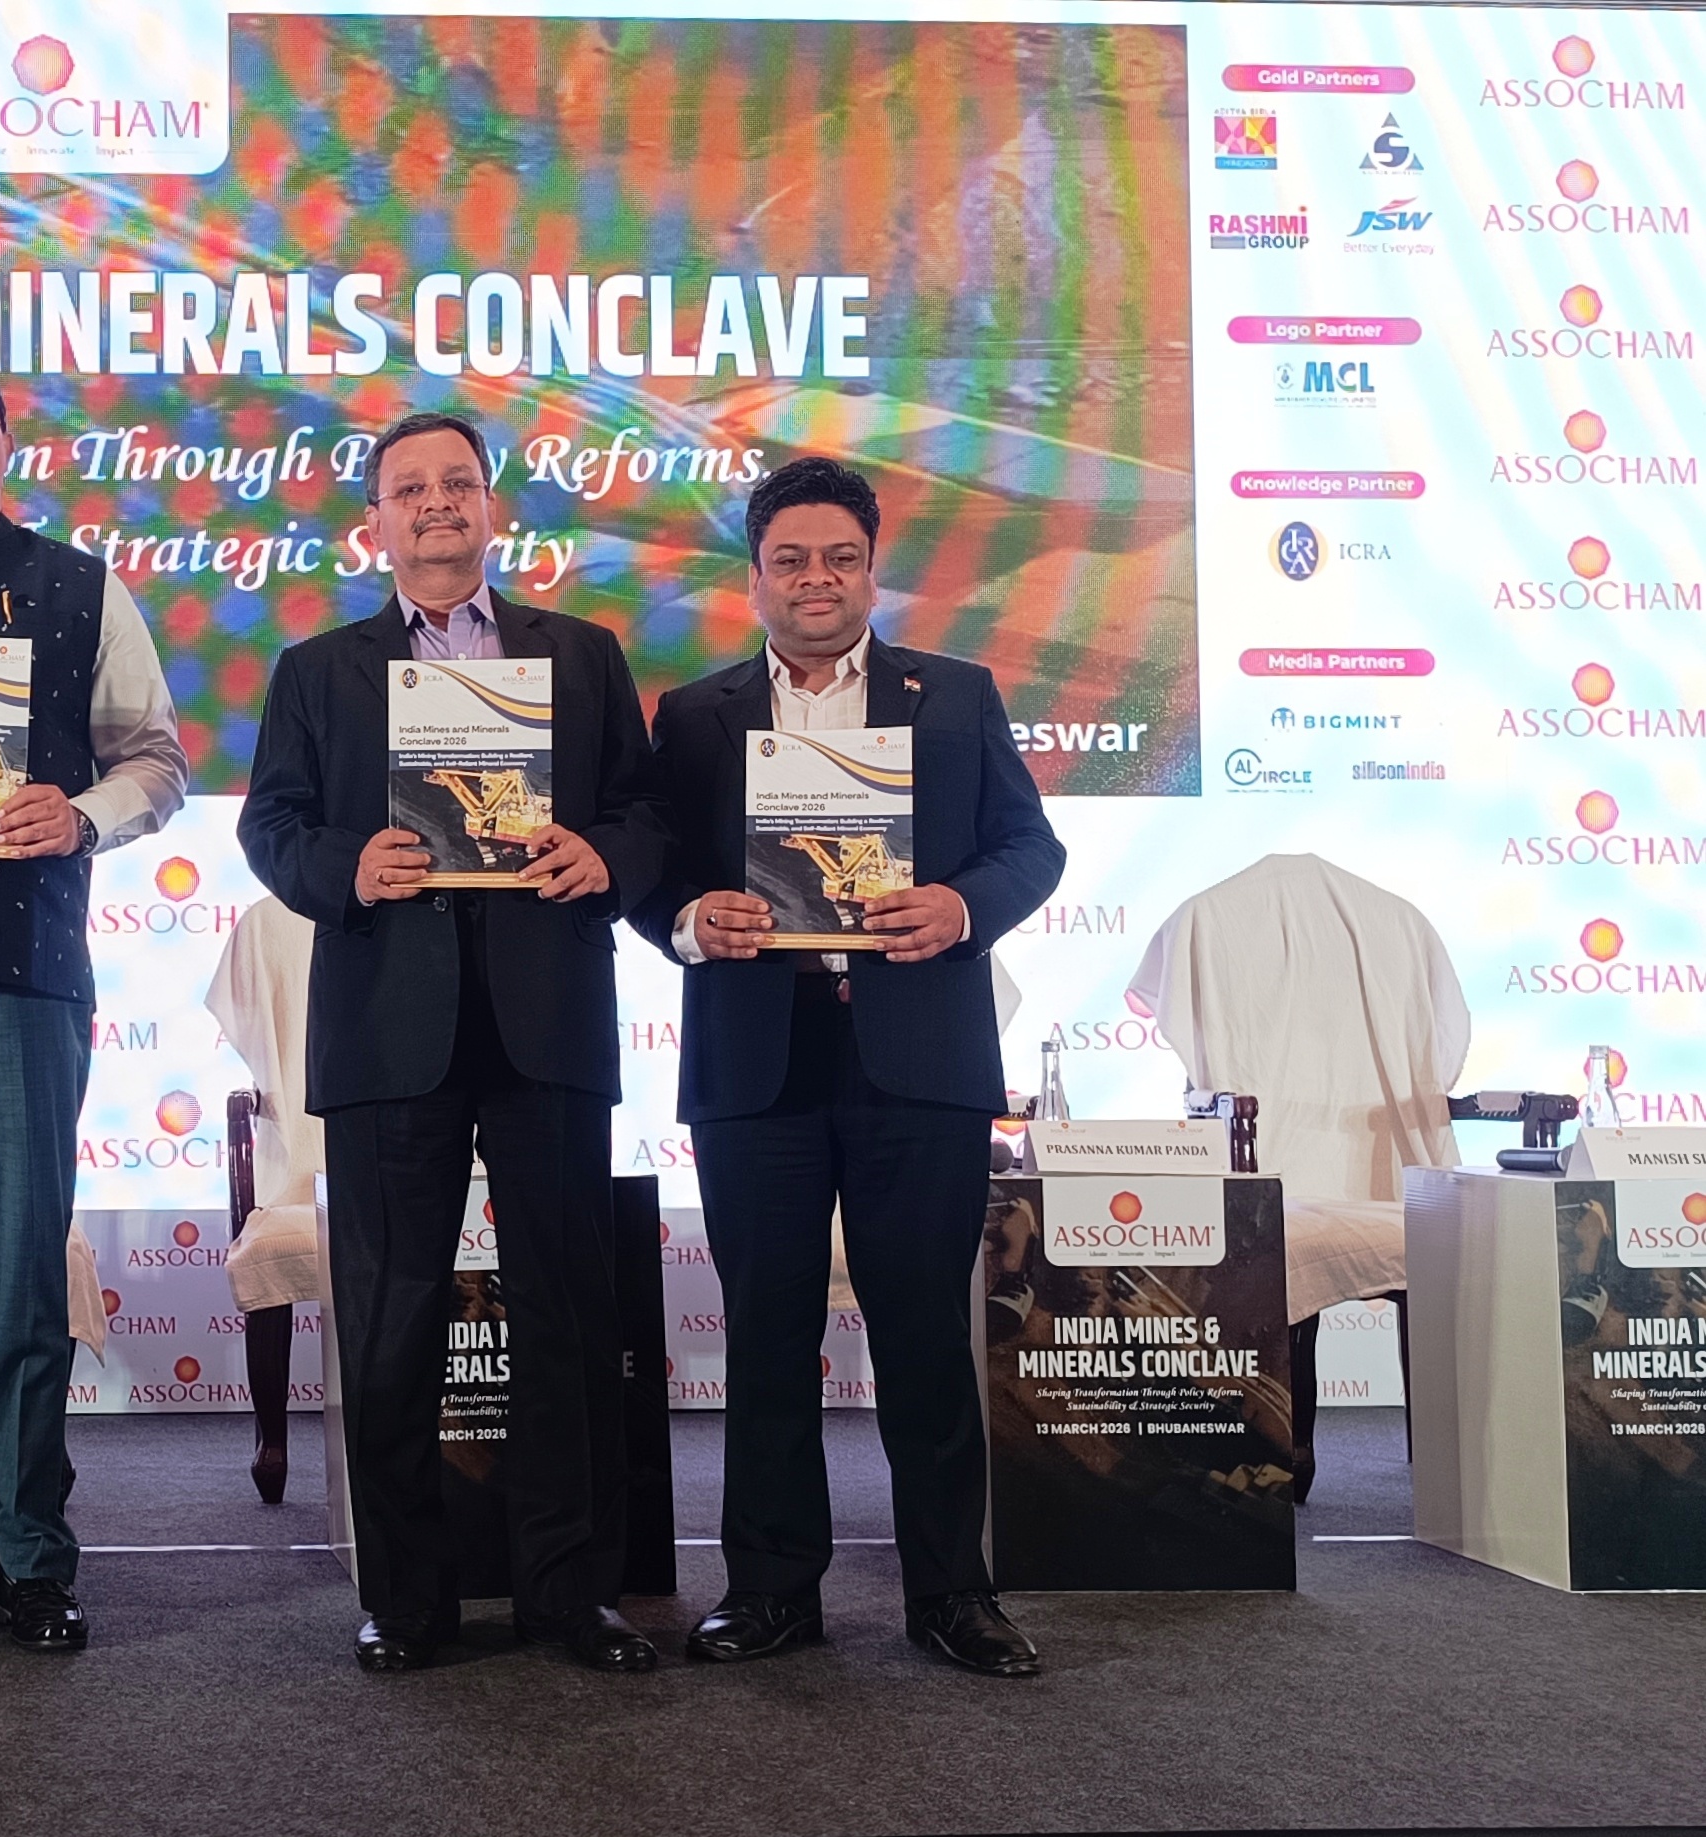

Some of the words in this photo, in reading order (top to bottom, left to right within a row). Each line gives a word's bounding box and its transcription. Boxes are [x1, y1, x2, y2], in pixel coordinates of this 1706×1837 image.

[1258, 70, 1299, 85] Gold
[1303, 70, 1380, 87] Partners
[1479, 79, 1685, 109] ASSOCHAM
[1346, 211, 1433, 237] JSW
[1482, 203, 1690, 234] ASSOCHAM
[1248, 235, 1310, 250] GROUP
[1343, 243, 1378, 253] Better
[1382, 243, 1435, 256] Everyday
[414, 274, 870, 378] CONCLAVE
[1266, 322, 1311, 340] Logo
[1315, 323, 1383, 337] Partner
[1486, 328, 1693, 359] ASSOCHAM
[1303, 361, 1375, 393] MCL
[72, 425, 314, 501] Through
[1490, 454, 1697, 485] ASSOCHAM
[1240, 476, 1343, 495] Knowledge
[1347, 476, 1415, 492] Partner
[72, 519, 321, 591] Strategic
[1339, 543, 1392, 560] ICRA
[1493, 580, 1702, 611] ASSOCHAM
[1268, 653, 1323, 669] Media
[1328, 654, 1406, 670] Partners
[399, 725, 421, 733] India
[423, 725, 450, 733] Mines
[452, 725, 469, 733] and
[472, 725, 510, 733] Minerals
[1303, 715, 1402, 729] BIGMINT
[1497, 708, 1706, 738] ASSOCHAM
[399, 737, 441, 745] Conclave
[444, 737, 467, 745] 2026
[756, 792, 778, 800] India
[781, 792, 808, 800] Mines
[810, 791, 828, 800] and
[830, 791, 869, 800] Minerals
[756, 803, 799, 811] Conclave
[802, 803, 825, 811] 2026
[1501, 835, 1706, 865] ASSOCHAM
[1046, 1144, 1114, 1156] PRASANNA
[1116, 1144, 1163, 1156] KUMAR
[1165, 1145, 1209, 1157] PANDA
[1628, 1153, 1688, 1165] MANISH
[1053, 1224, 1211, 1248] ASSOCHAM
[1626, 1225, 1706, 1249] ASSO
[109, 1316, 176, 1334] CHAM
[1320, 1311, 1394, 1331] ASSOC
[1054, 1317, 1119, 1345] INDIA
[1124, 1316, 1198, 1345] MINES
[1204, 1316, 1221, 1344] &
[1628, 1317, 1693, 1345] INDIA
[445, 1354, 510, 1383] ERALS
[1018, 1350, 1136, 1379] MINERALS
[1141, 1349, 1259, 1378] CONCLAVE
[1593, 1350, 1706, 1379] MINERALS
[1035, 1387, 1071, 1399] Shaping
[1073, 1386, 1139, 1399] Transformation
[1141, 1386, 1176, 1399] Through
[1178, 1386, 1205, 1399] Policy
[1207, 1386, 1244, 1399] Reforms,
[1610, 1388, 1645, 1401] Shaping
[441, 1406, 503, 1418] Sustainability
[1066, 1401, 1127, 1413] Sustainability
[1139, 1401, 1178, 1413] Strategic
[1179, 1401, 1215, 1413] Security
[1641, 1402, 1701, 1413] Sustainability
[439, 1430, 474, 1441] ARCH
[476, 1429, 507, 1440] 2026
[1036, 1423, 1049, 1435] 13
[1051, 1423, 1098, 1434] MARCH
[1100, 1422, 1131, 1434] 2026
[1147, 1422, 1245, 1434] BHUBANESWAR
[1611, 1424, 1623, 1435] 13
[1626, 1424, 1673, 1435] MARCH
[1675, 1423, 1706, 1434] 2026
